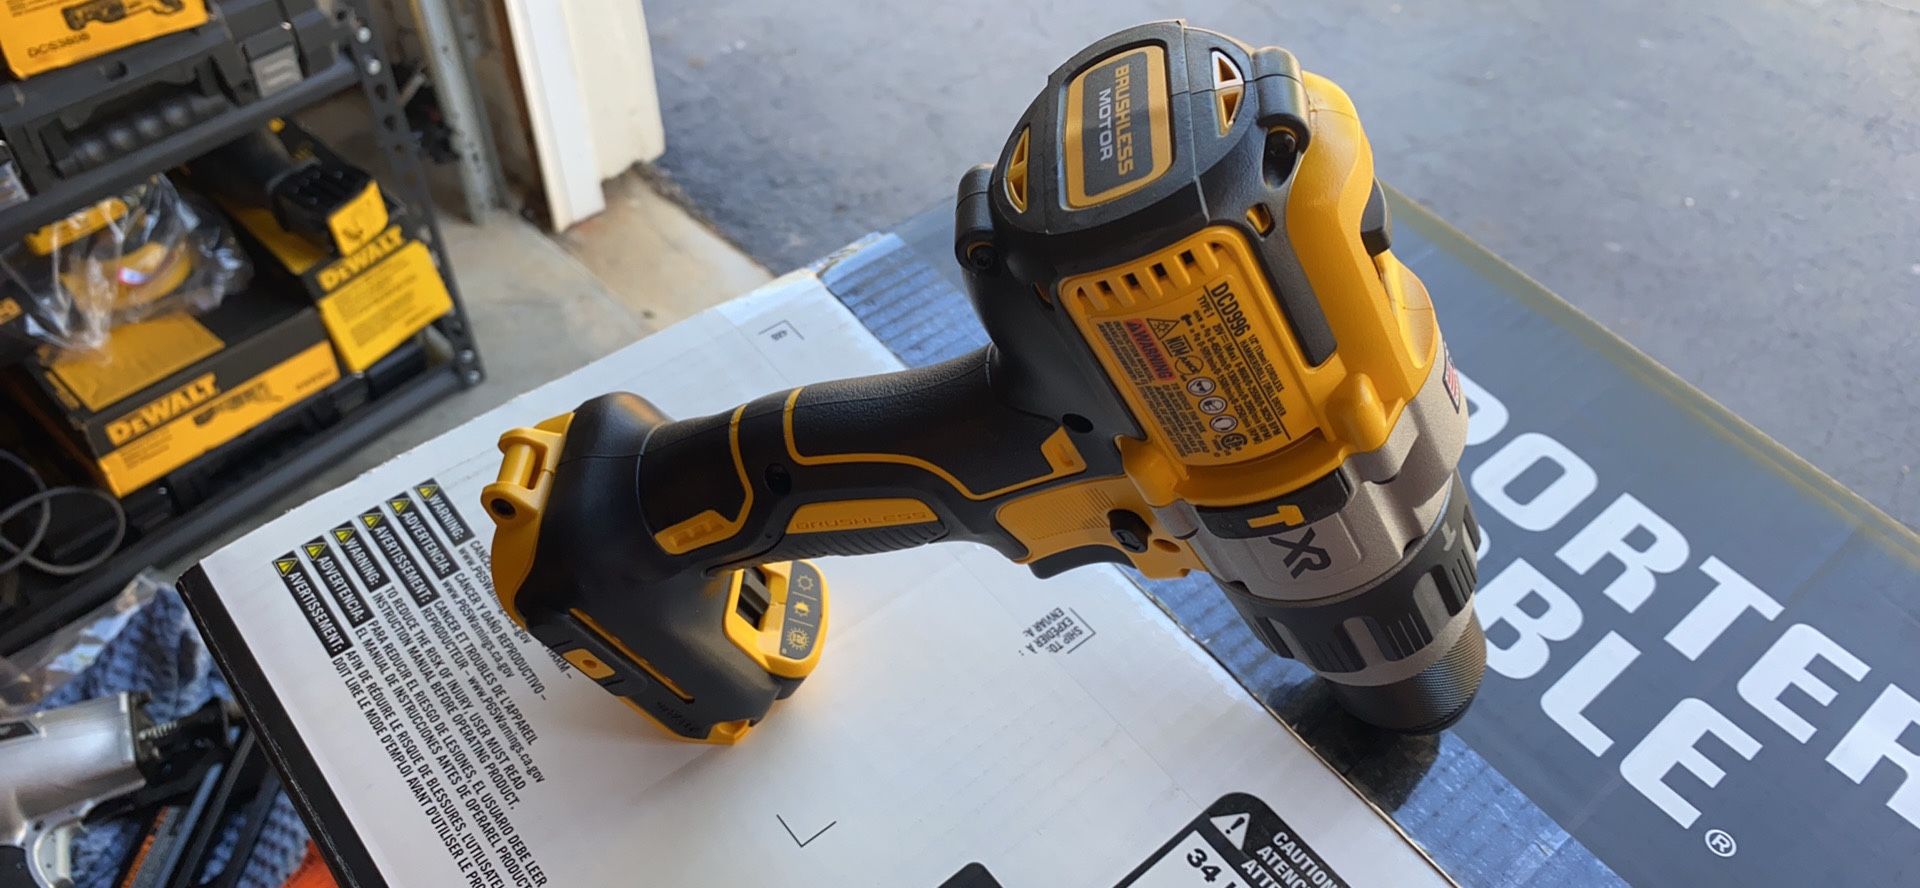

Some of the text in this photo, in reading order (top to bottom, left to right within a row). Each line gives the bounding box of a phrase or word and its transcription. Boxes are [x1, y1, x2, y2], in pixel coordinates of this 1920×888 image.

[1099, 87, 1114, 161] MOTOR
[1115, 63, 1135, 176] BRUSHLESS
[1197, 294, 1213, 314] TYPE
[1210, 282, 1250, 337] DCD996
[1133, 330, 1173, 378] WARNING
[1264, 363, 1284, 393] CORDLESS
[105, 372, 221, 447] DEWALT
[429, 494, 464, 540] WARNING:
[402, 512, 450, 574] ADVERTENCIA:
[1269, 528, 1332, 579] XR
[454, 573, 482, 605] CÁNCER
[476, 603, 487, 611] Y
[374, 526, 538, 746] AVERTISSEMENT: CANCER ET TROUBLES DE L'APPAREIL
[480, 610, 503, 634] DAÑO
[1033, 607, 1064, 632] ENVIAR
[1033, 617, 1074, 648] EXPÉDIER
[1046, 626, 1083, 653] SHIP TO:
[332, 657, 352, 678] DOIT
[345, 538, 526, 790] WARNING: TO REDUCE THE RISK OF INJURY, USER MUST READ
[497, 633, 545, 694] REPRODUCTIVO
[345, 677, 364, 698] LIRE
[357, 696, 372, 710] LE
[372, 593, 520, 810] INSTRUCTION MANUAL BEFORE OPERATING PRODUCT.
[421, 607, 469, 671] REPRODUCTEUR
[468, 676, 545, 783] www.P65Warnings.ca.gov
[288, 572, 505, 888] AVERTISSEMENT: AFIN DE RÉDUIRE LE RISQUE DE BLESSURES, L'UTILISATE
[317, 556, 547, 888] ADVERTENCIA: PARA REDUCIR EL RIESGO DE LESIONES, EL USUARIO DEBE LEER
[355, 627, 368, 640] EL
[362, 638, 390, 675] MANUAL
[384, 673, 399, 687] DE
[393, 686, 443, 755] INSTRUCCIONES
[436, 754, 462, 785] ANTES
[456, 784, 472, 799] DE
[465, 798, 502, 848] OPERAREL
[364, 708, 388, 736] MODE
[380, 734, 414, 778] D'EMPLOI
[406, 777, 433, 806] AVANT
[425, 806, 464, 859] D'UTILISER
[457, 857, 473, 873] LE
[1187, 848, 1222, 882] 34
